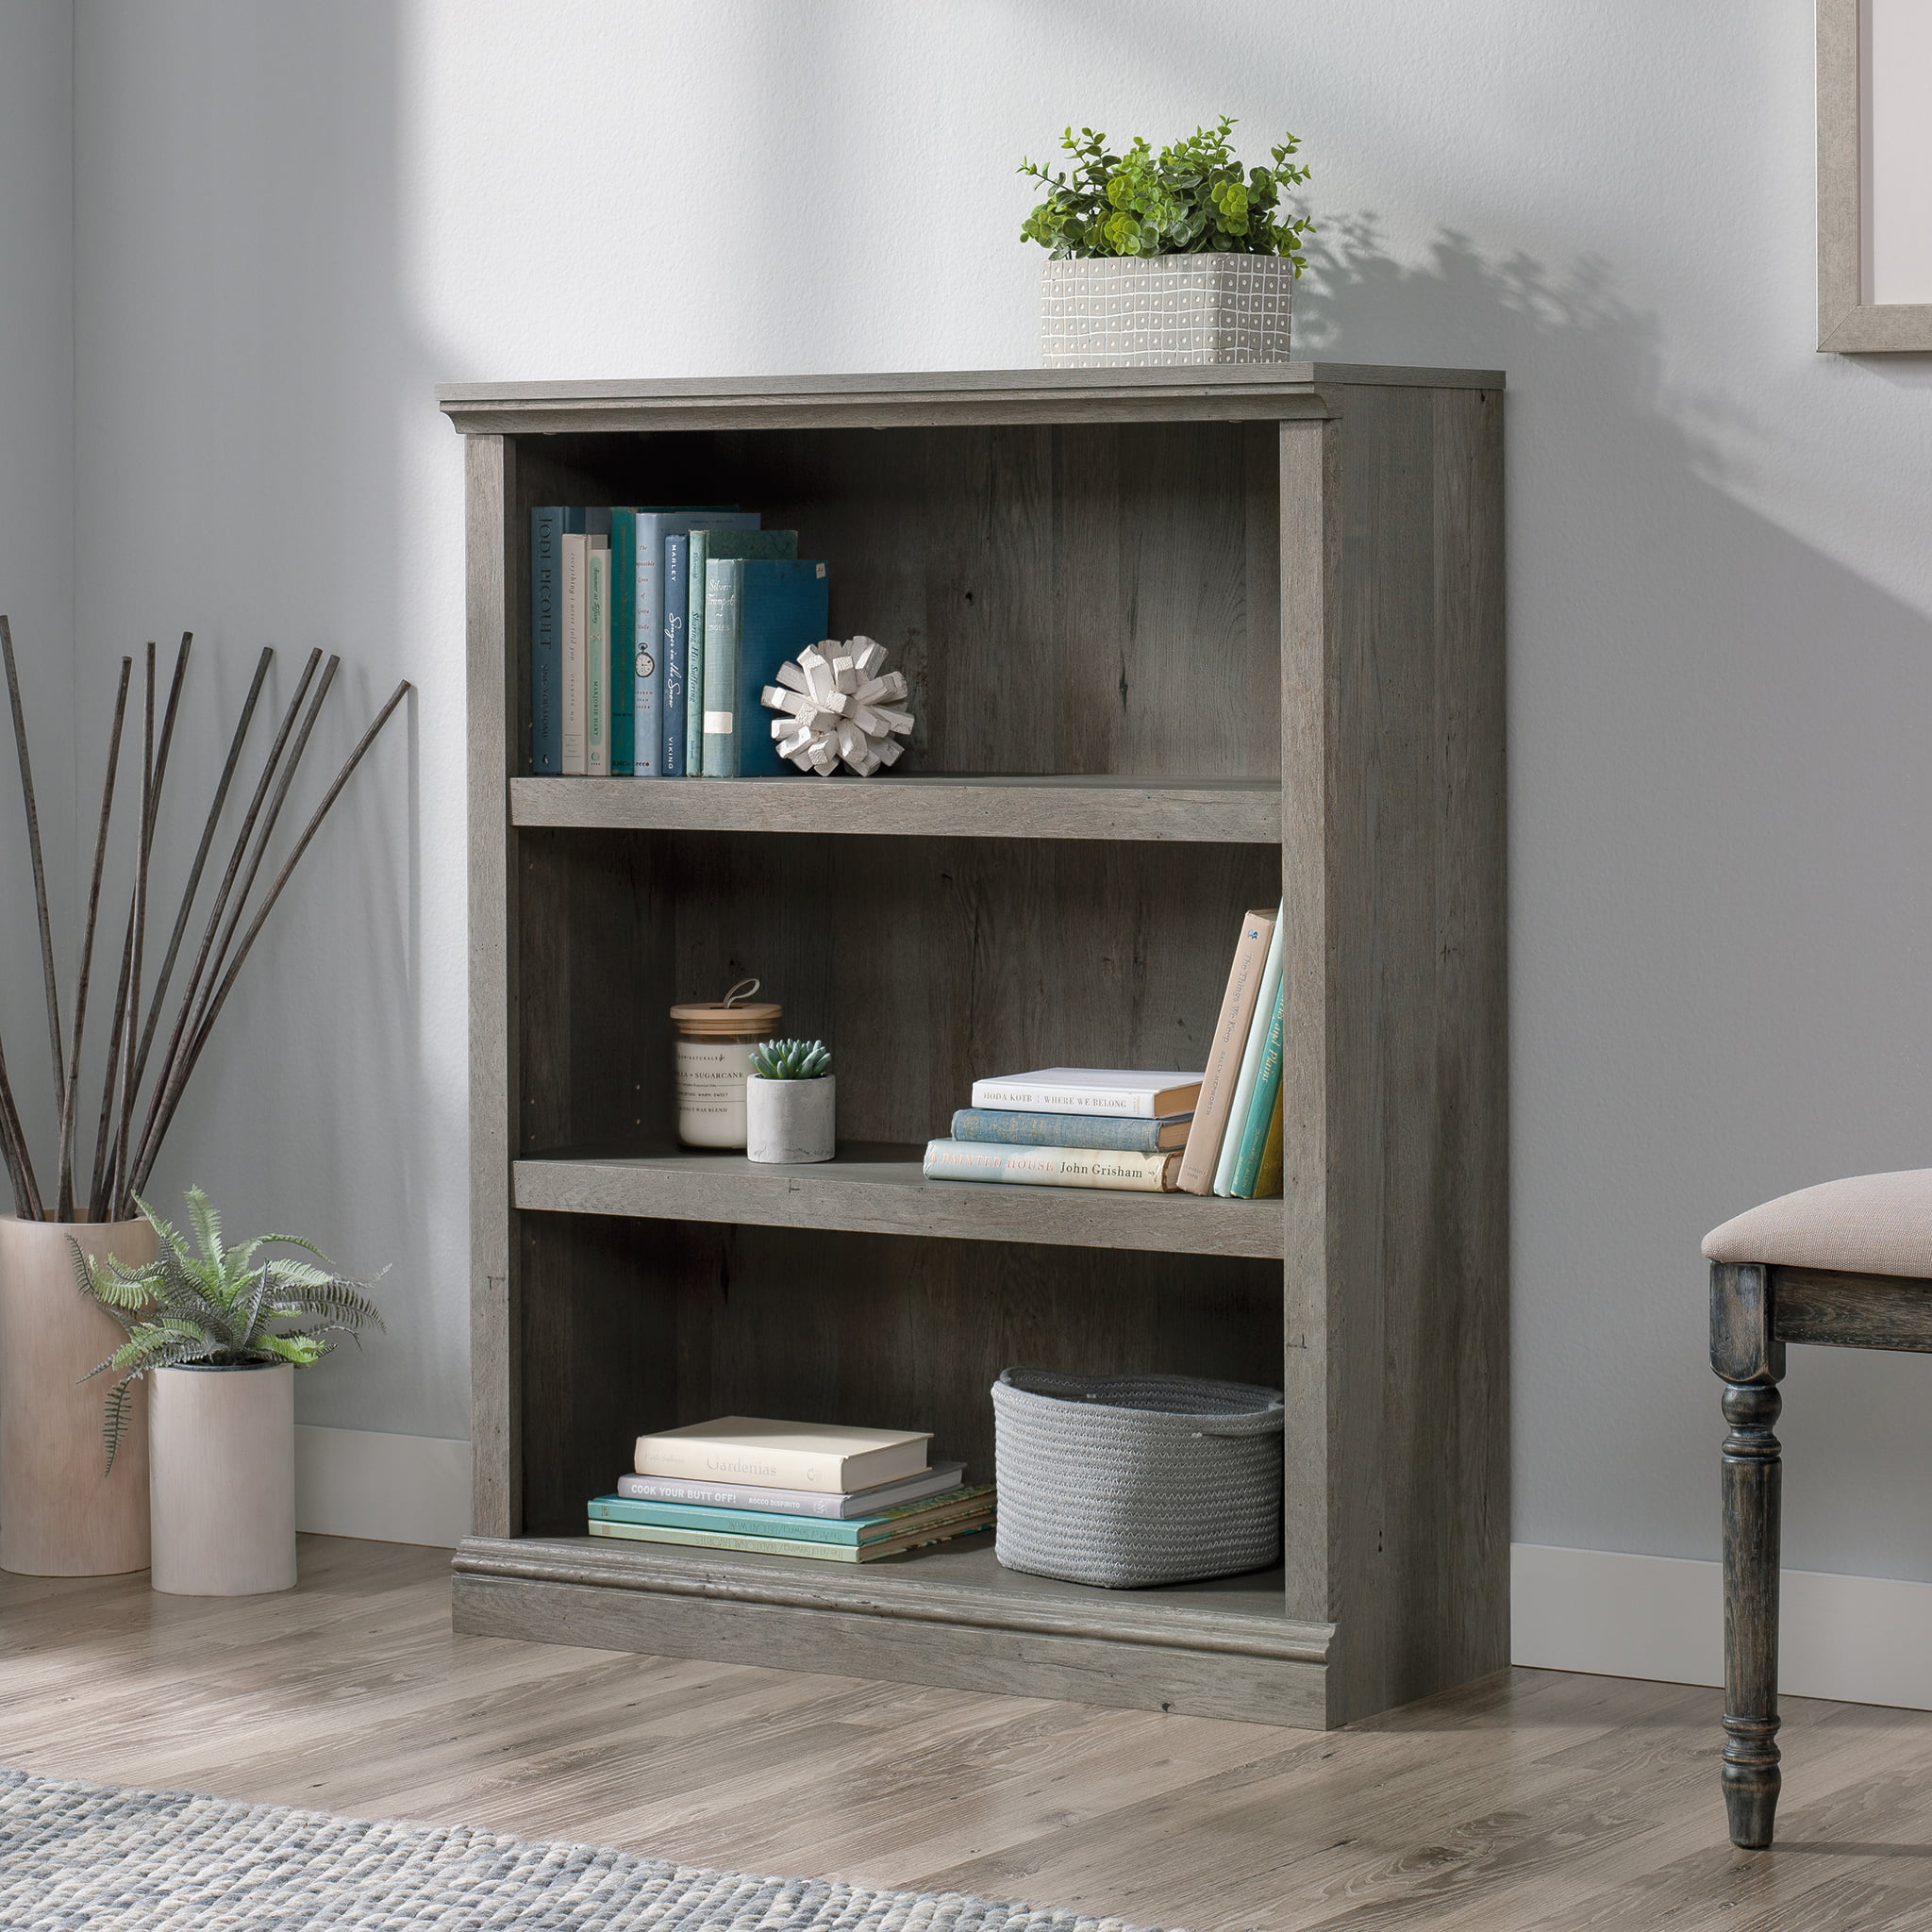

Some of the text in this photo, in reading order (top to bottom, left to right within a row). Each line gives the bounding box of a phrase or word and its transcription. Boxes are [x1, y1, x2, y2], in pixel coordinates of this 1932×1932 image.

[538, 516, 552, 649] JODI PICOULT
[708, 578, 731, 591] Silver
[707, 593, 735, 612] Trumpet
[689, 610, 700, 703] Sharing His Suffering
[670, 661, 682, 678] the
[667, 678, 681, 708] Snow
[1233, 973, 1248, 1003] Things
[1223, 1020, 1237, 1043] Keep
[1271, 1023, 1282, 1047] and
[1262, 1049, 1278, 1082] Plains
[983, 1091, 1008, 1101] HODA
[1009, 1093, 1033, 1103] KOTB
[1043, 1094, 1074, 1105] WHERE
[1077, 1097, 1091, 1106] WE
[1092, 1098, 1128, 1108] BELONG
[930, 1152, 1055, 1172] A PAINTED HOUSE
[1059, 1160, 1143, 1179] John Grisham
[705, 1456, 778, 1477] Gardenias
[631, 1484, 737, 1504] COOK YOUR BUTT OFF!
[748, 1497, 801, 1509] ROCCO DISPIRITO
